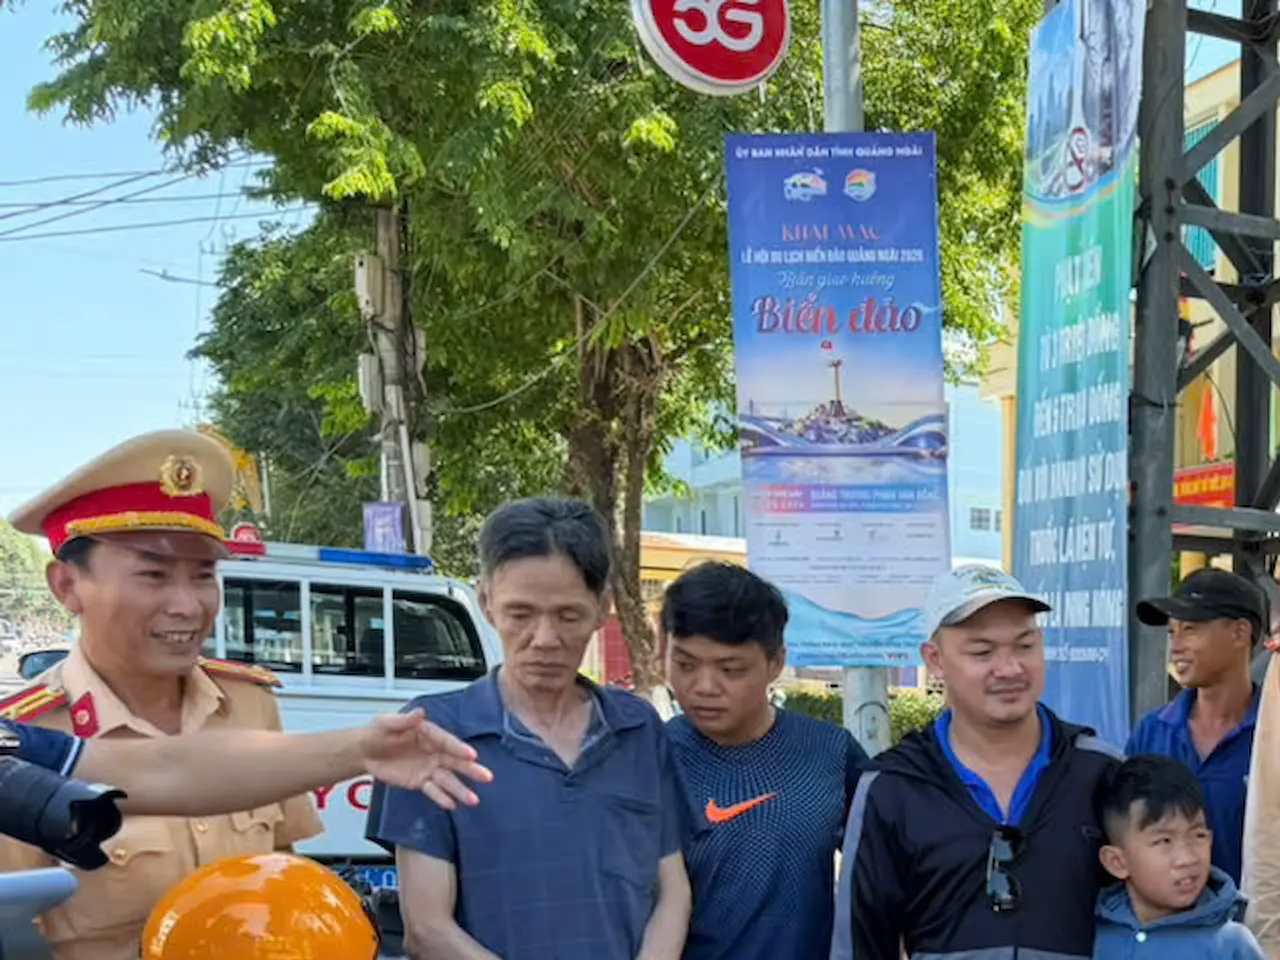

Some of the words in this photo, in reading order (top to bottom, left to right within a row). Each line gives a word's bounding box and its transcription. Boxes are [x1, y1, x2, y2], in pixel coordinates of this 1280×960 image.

[672, 0, 764, 52] 5G
[751, 148, 773, 158] BAN
[752, 292, 844, 335] Biển
[849, 297, 923, 335] đảo
